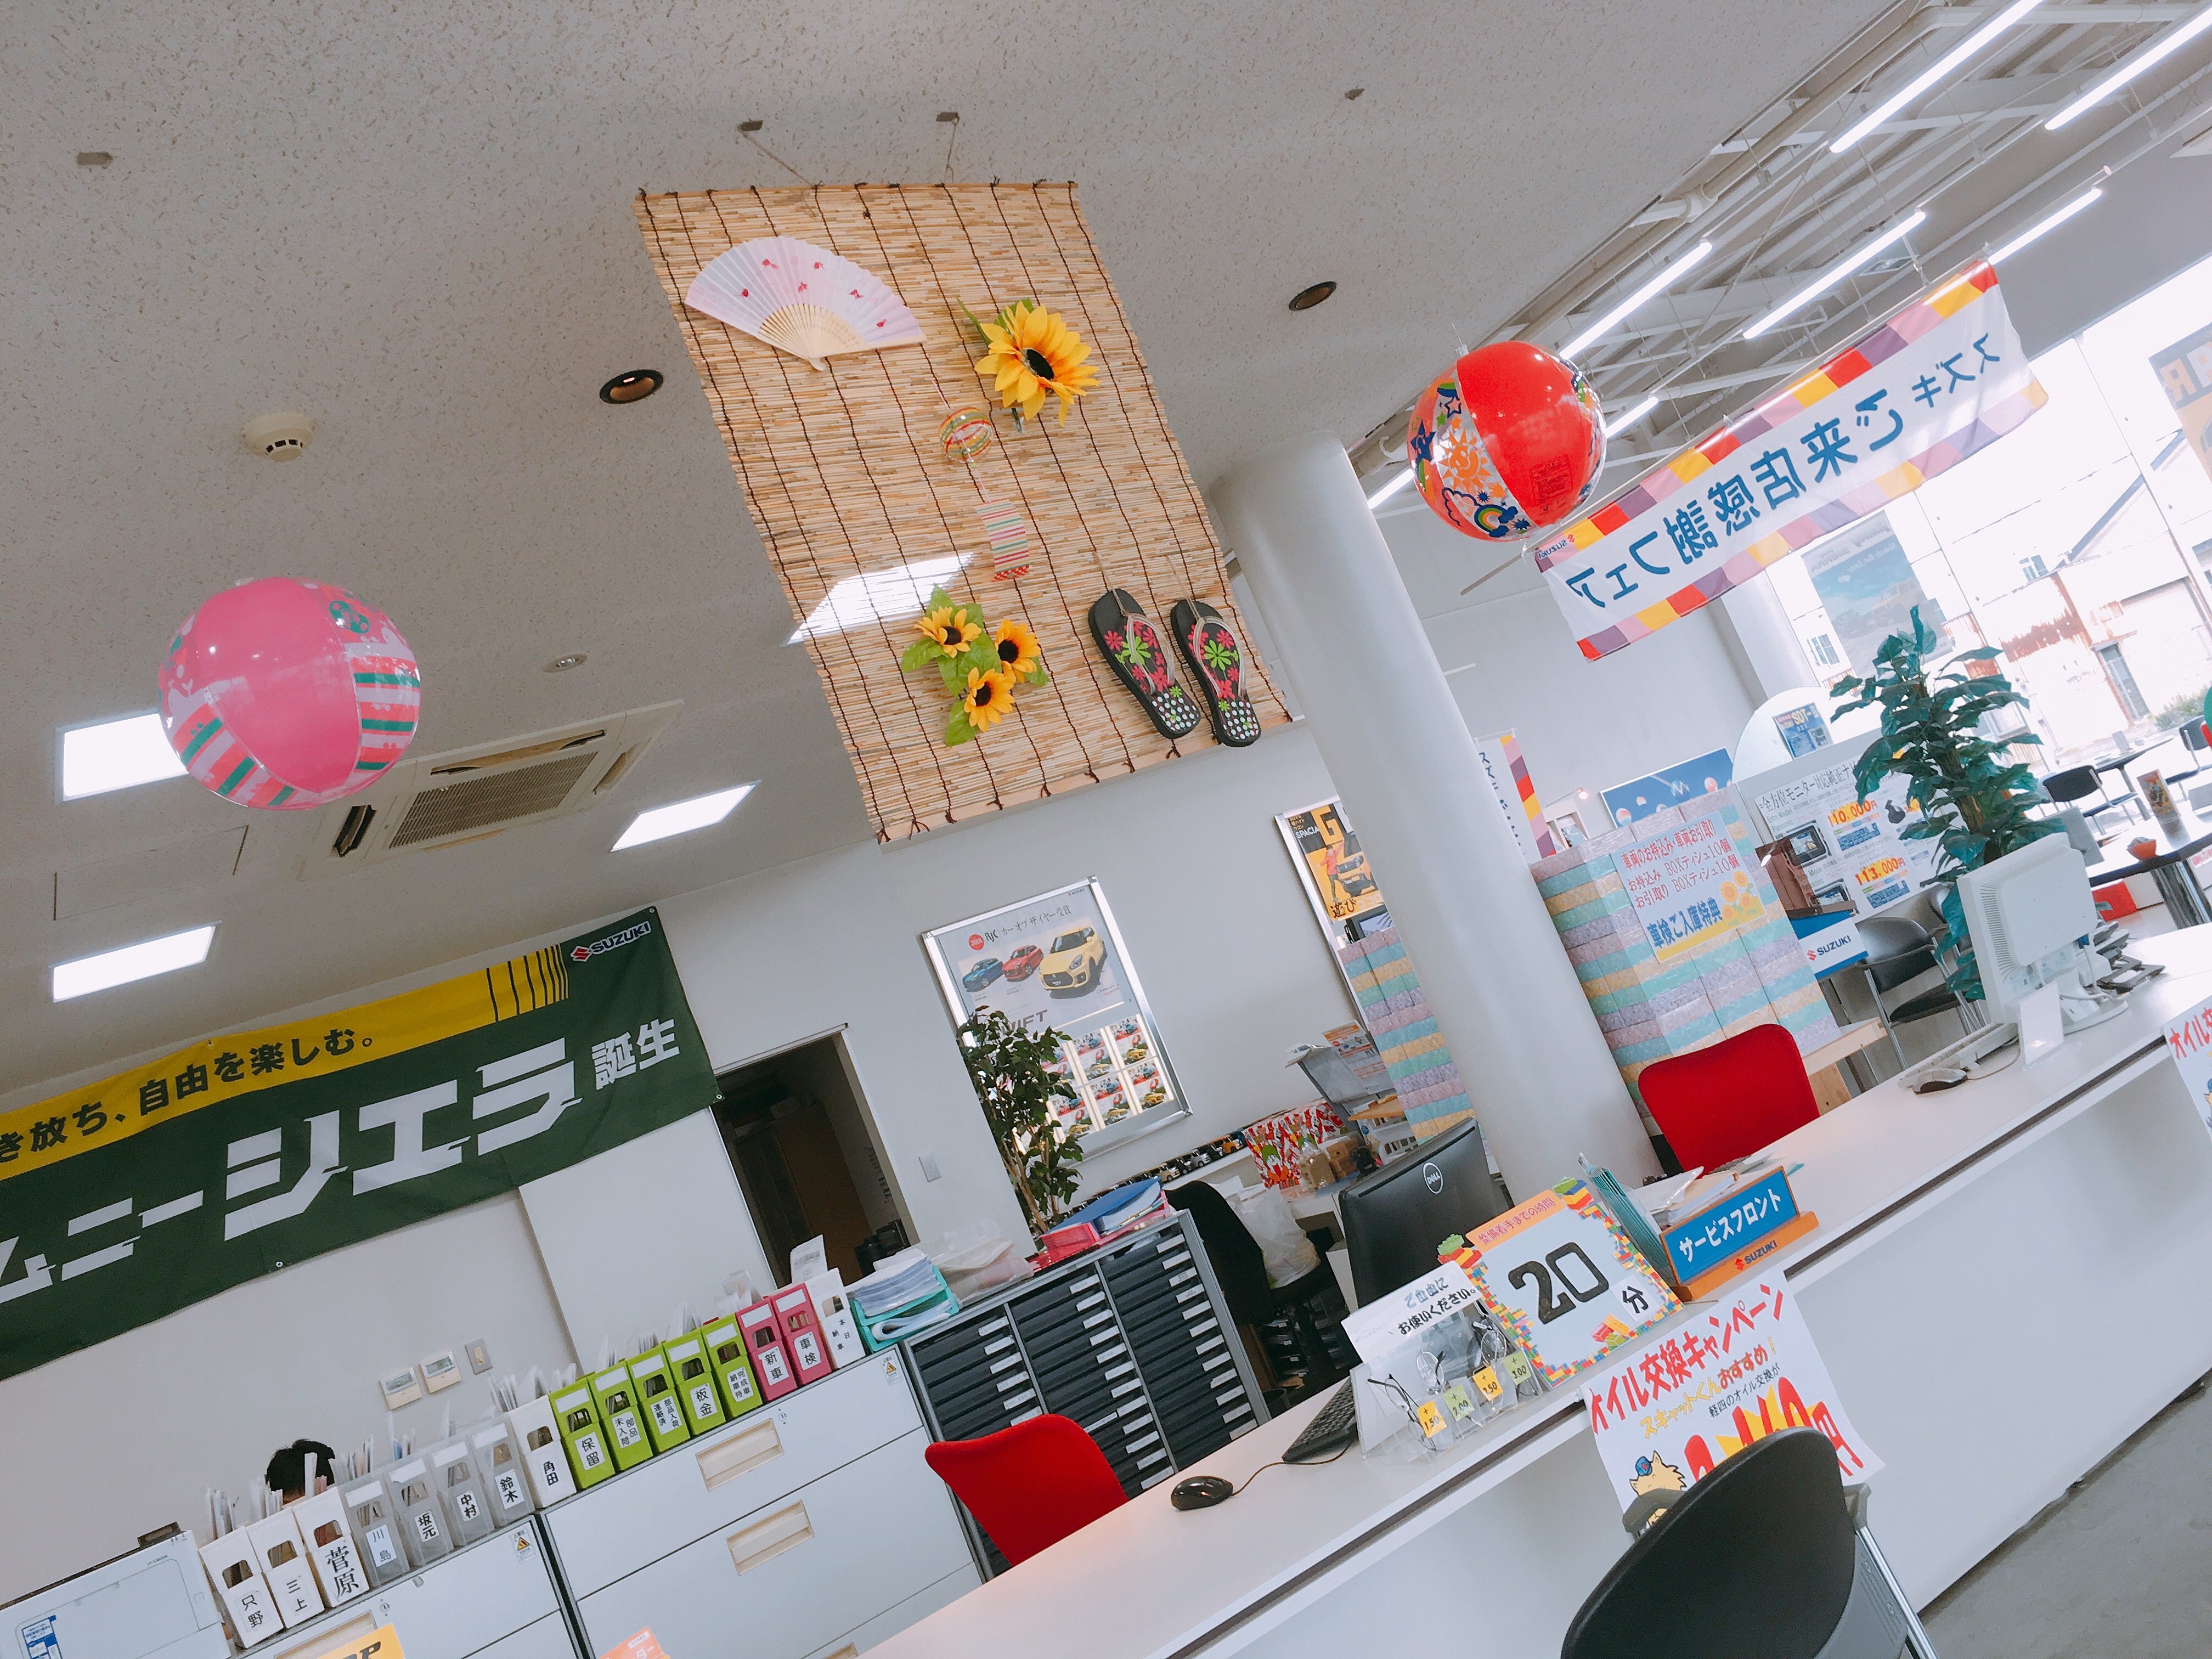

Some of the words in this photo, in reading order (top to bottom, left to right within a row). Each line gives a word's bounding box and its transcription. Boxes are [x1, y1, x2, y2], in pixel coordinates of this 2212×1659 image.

[1295, 826, 1320, 839] SPACIA
[1628, 869, 1662, 891] お持込み
[1635, 884, 1669, 909] お引取り
[1647, 896, 1723, 949] 車検ご入庫特典
[591, 921, 651, 955] SUZUKI
[1817, 935, 1852, 955] SUZUKI
[591, 1019, 680, 1090] 誕生
[1426, 1171, 1441, 1185] DELL
[1679, 1188, 1781, 1263] サービスフロント
[1744, 1239, 1778, 1265] SUZUKI
[1508, 1242, 1609, 1325] 20
[1622, 1285, 1649, 1314] 分
[1397, 1285, 1476, 1335] お使いください。
[764, 1351, 783, 1380] 新車
[799, 1337, 817, 1365] 車検
[1589, 1284, 1784, 1435] オイル交換キャンペーン
[695, 1387, 713, 1417] 板金
[1708, 1362, 1781, 1418] 軽四のオイル交換が
[614, 1418, 630, 1447] 未入荷
[625, 1417, 638, 1438] 部品
[581, 1437, 601, 1466] 保留
[543, 1460, 560, 1486] 角田
[500, 1476, 518, 1504] 鈴木
[460, 1493, 478, 1519] 中村
[417, 1512, 438, 1540] 坂元
[325, 1544, 360, 1599] 菅原
[286, 1578, 308, 1612] 三上
[241, 1595, 264, 1628] 只野
